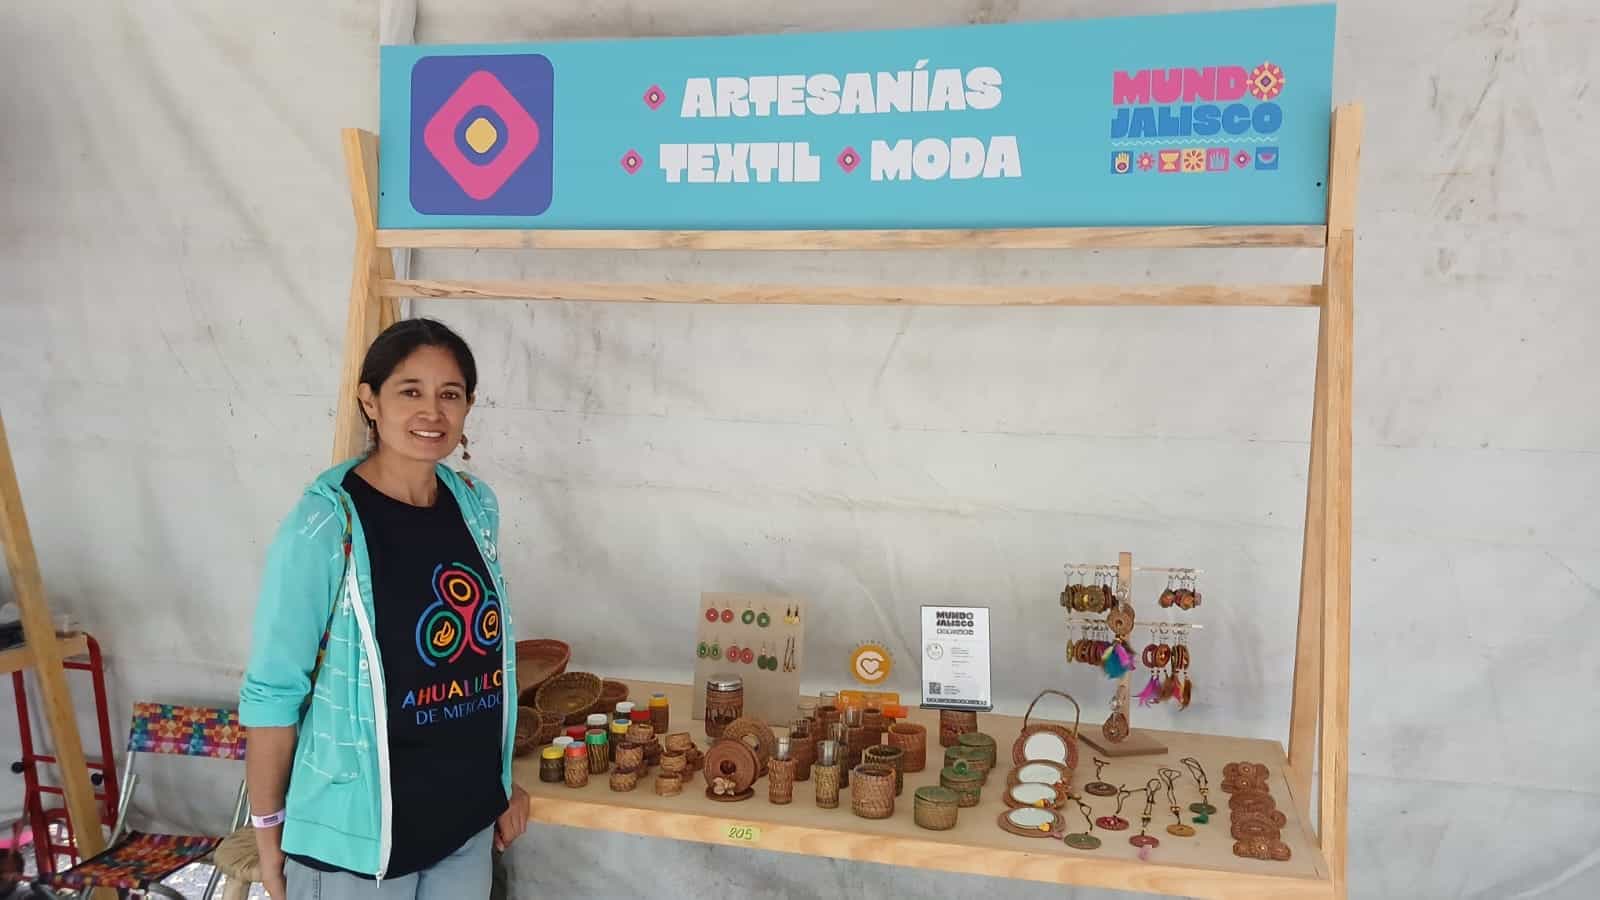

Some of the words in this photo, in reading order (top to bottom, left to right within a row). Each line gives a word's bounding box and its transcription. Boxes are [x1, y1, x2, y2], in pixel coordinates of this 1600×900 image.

[680, 58, 1002, 118] ARTESANÍAS
[1112, 60, 1286, 105] MUNDO
[1110, 102, 1283, 138] JALISCO
[659, 142, 821, 183] TEXTIL
[870, 135, 1022, 181] MODA
[936, 611, 974, 620] MUNDO
[936, 619, 974, 627] JALISCO
[416, 708, 439, 726] DE
[728, 826, 753, 840] 205
